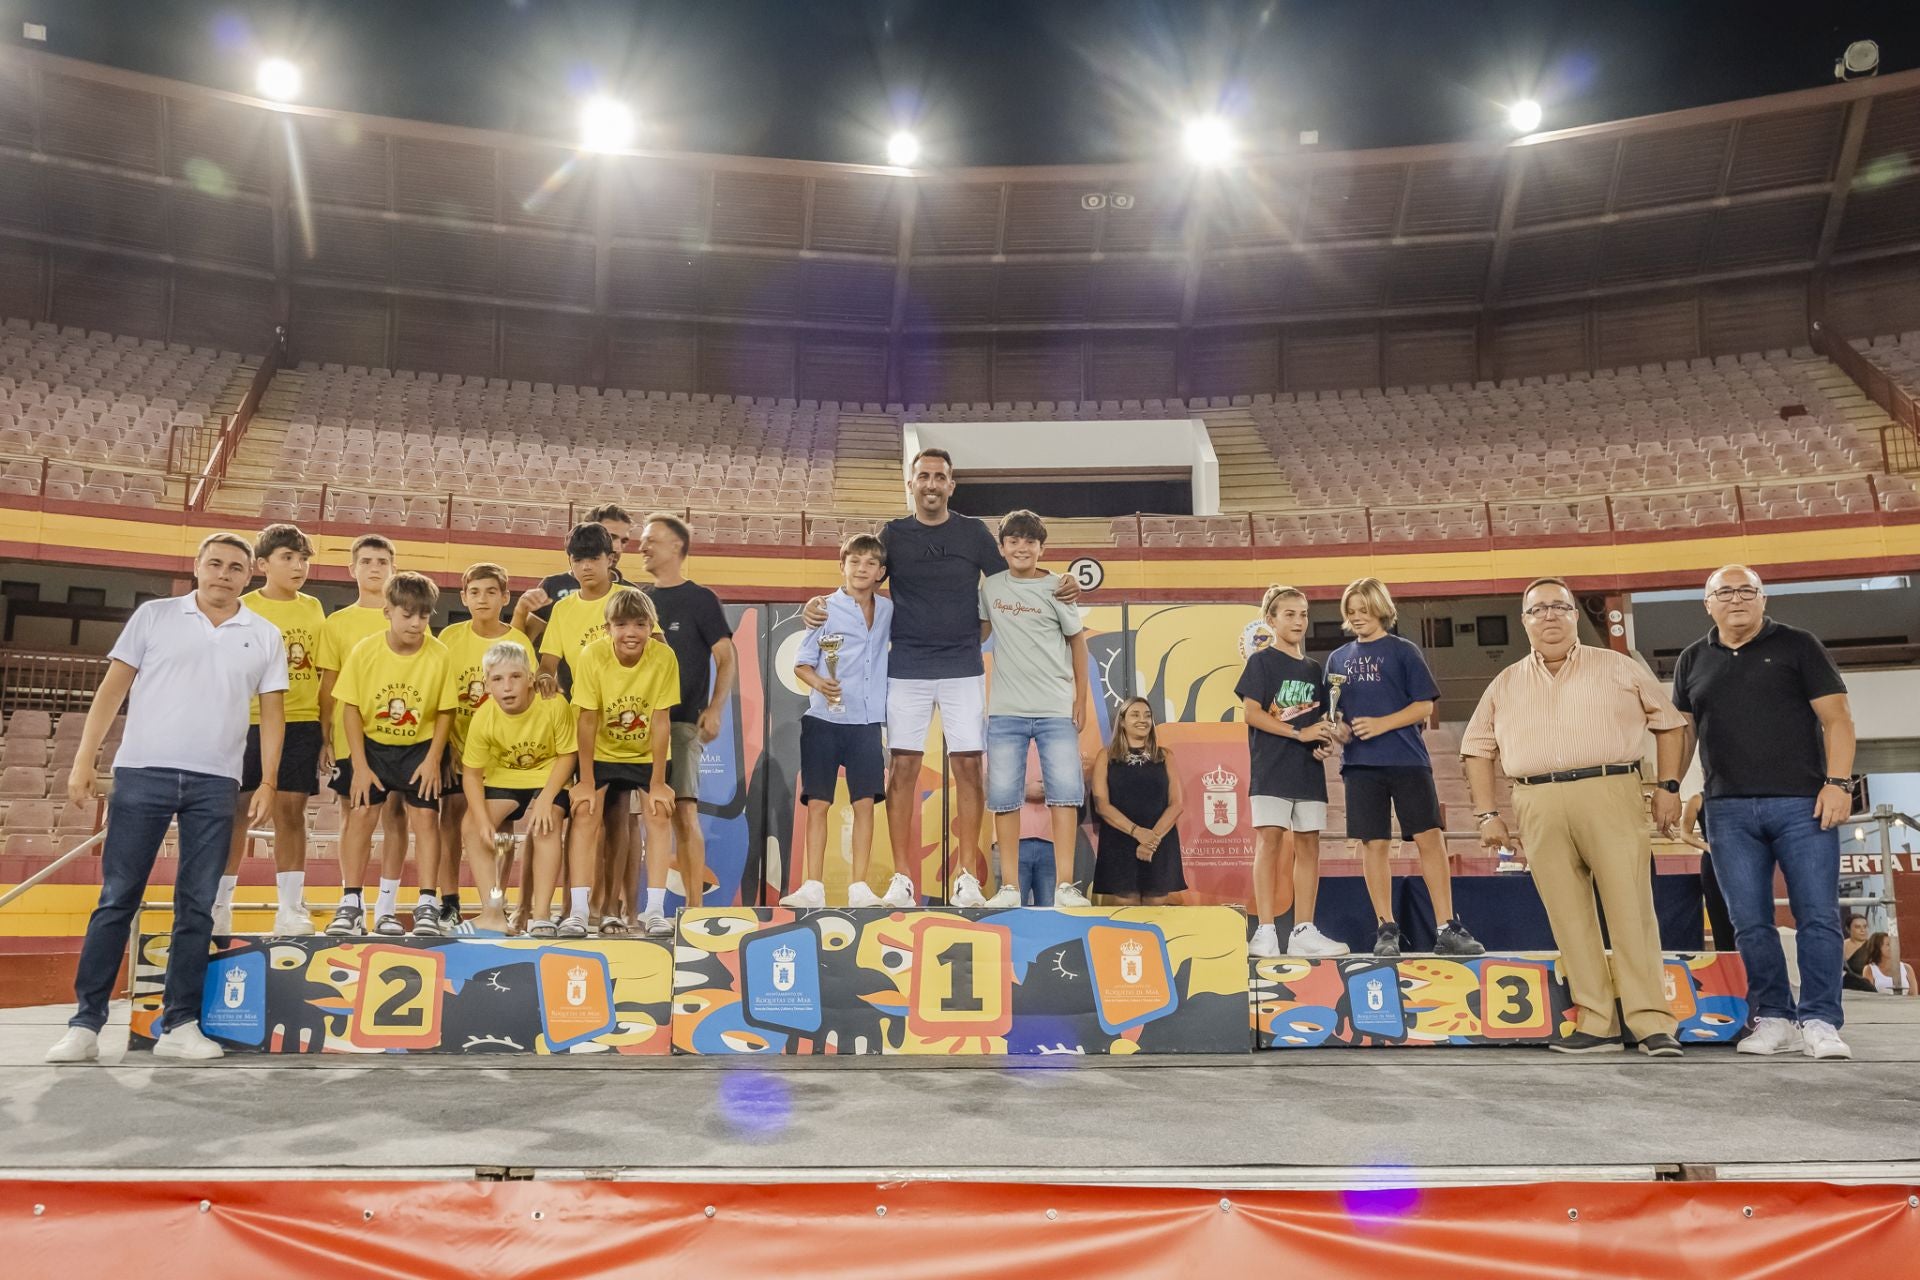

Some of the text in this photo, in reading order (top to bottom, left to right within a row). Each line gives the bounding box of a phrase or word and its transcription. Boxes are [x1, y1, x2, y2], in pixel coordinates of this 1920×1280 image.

[1079, 564, 1093, 586] 5
[993, 599, 1013, 613] Pepe
[282, 628, 314, 647] ARISCOS
[1343, 656, 1385, 668] CALVN
[1347, 664, 1378, 675] KLEIN
[375, 683, 423, 703] MARISCOS
[1277, 680, 1316, 707] NIKE
[376, 725, 416, 737] RECIO
[608, 730, 646, 741] RECIO
[700, 753, 722, 762] MAR
[1181, 846, 1225, 856] ROQUETAS
[1839, 854, 1904, 873] ERTA
[936, 943, 983, 1011] 1
[374, 965, 423, 1026] 2
[1496, 975, 1533, 1024] 3
